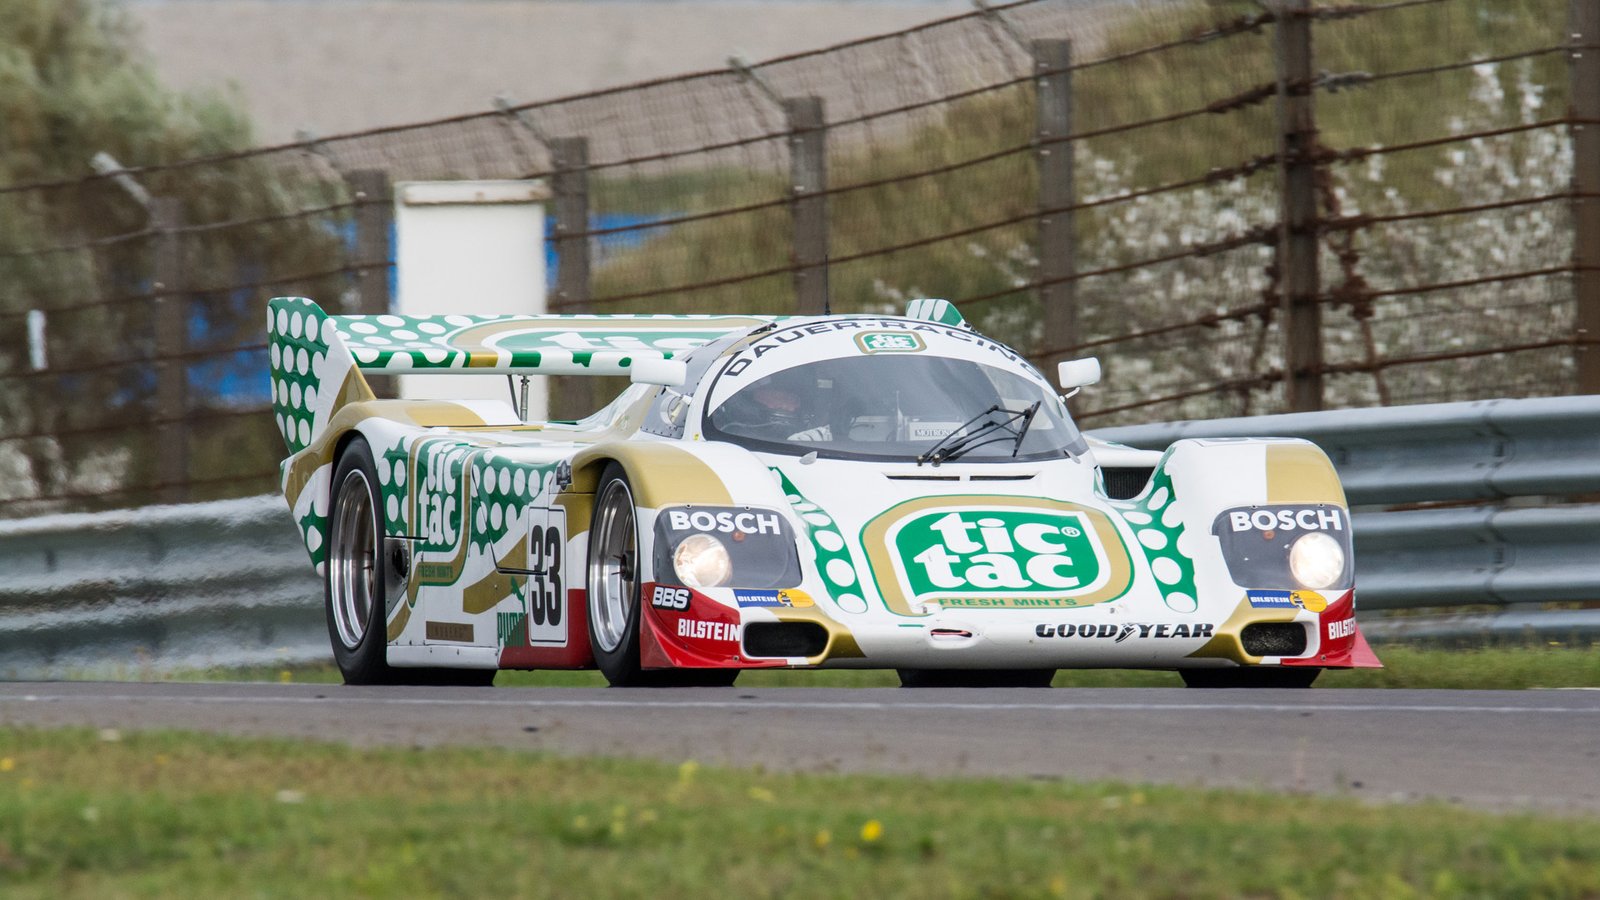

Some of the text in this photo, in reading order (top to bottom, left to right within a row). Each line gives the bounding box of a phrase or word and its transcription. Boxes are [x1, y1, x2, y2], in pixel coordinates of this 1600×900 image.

[418, 476, 456, 546] tac
[669, 510, 781, 535] BOSCH
[1229, 509, 1343, 532] BOSCH
[531, 525, 562, 626] 33
[913, 543, 1081, 588] tac
[652, 586, 691, 609] BBS
[937, 598, 1078, 607] FRESH MINTS
[677, 618, 741, 642] BILSTEIN
